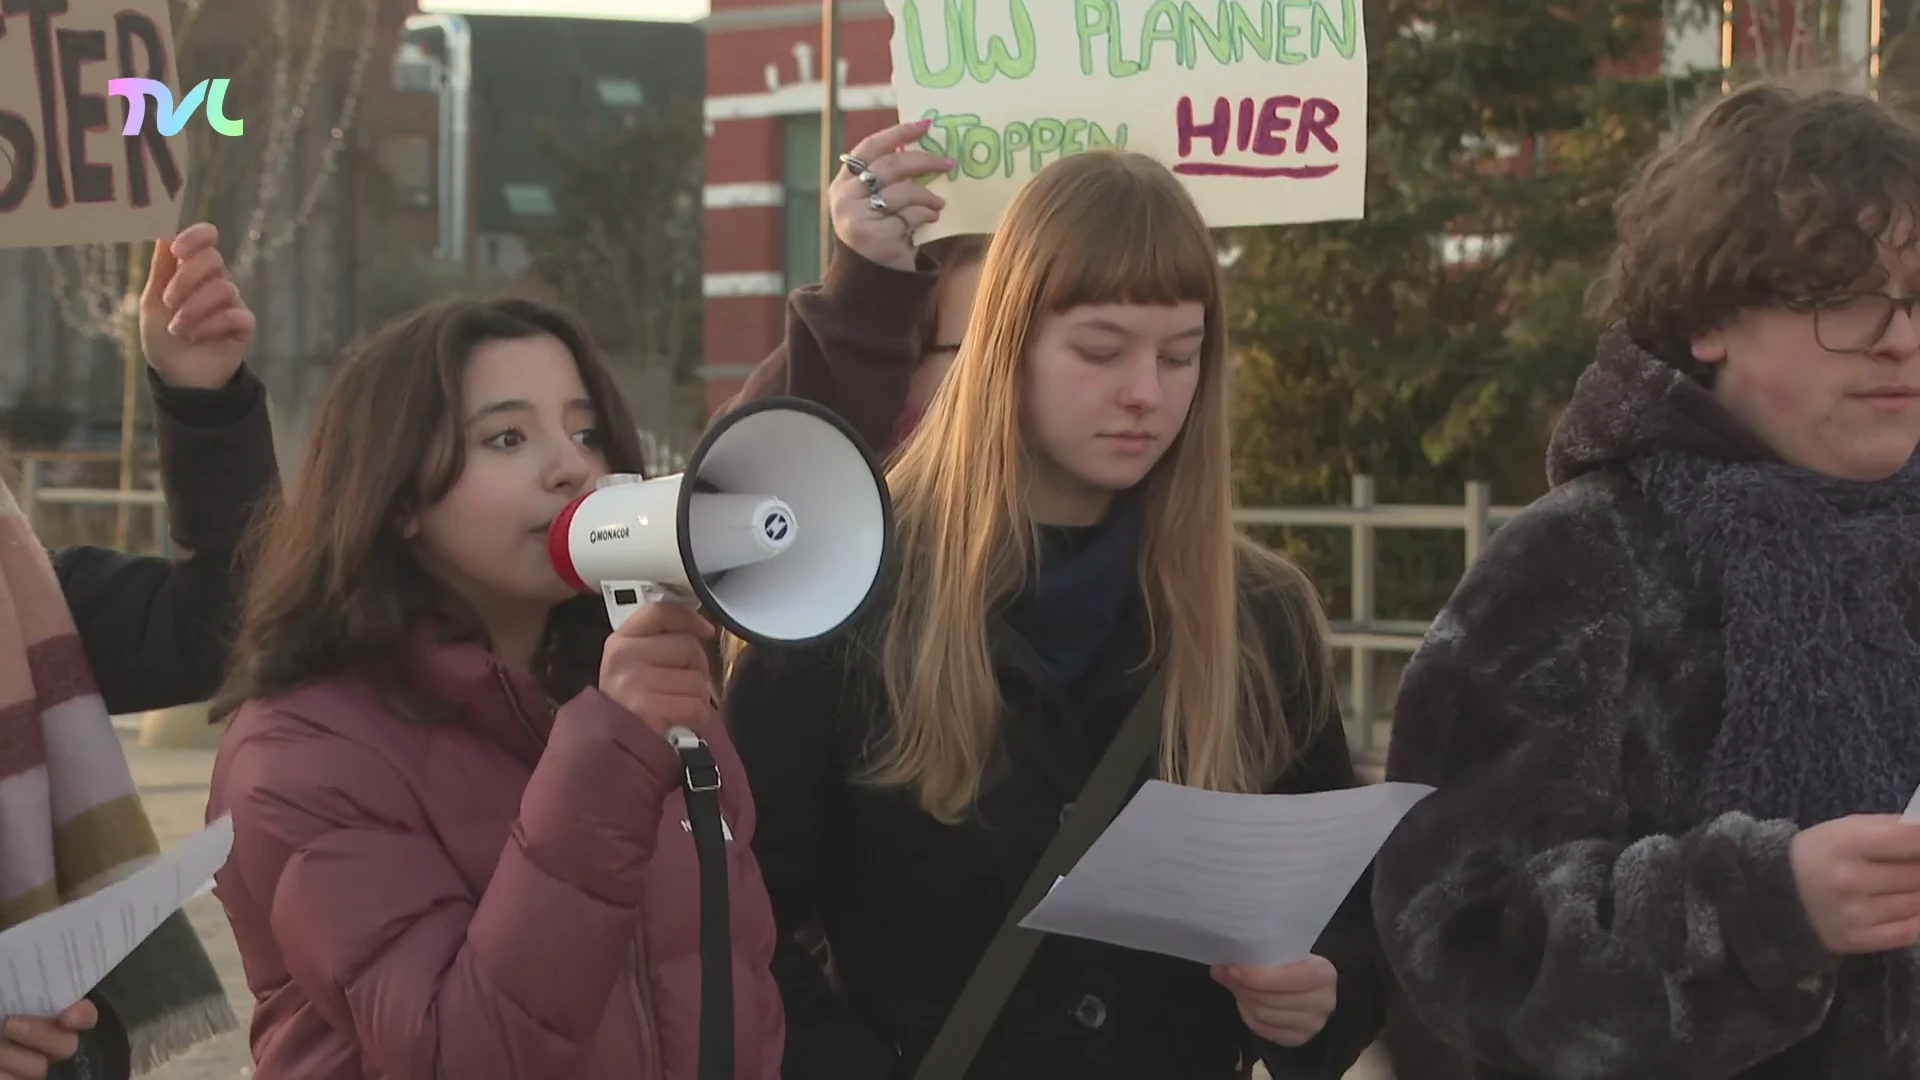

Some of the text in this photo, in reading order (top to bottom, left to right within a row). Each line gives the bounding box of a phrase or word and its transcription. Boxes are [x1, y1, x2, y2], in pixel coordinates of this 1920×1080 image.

[903, 0, 1357, 89] UW PLANNEN
[1176, 95, 1340, 158] HIER
[597, 527, 630, 541] MONACOR
